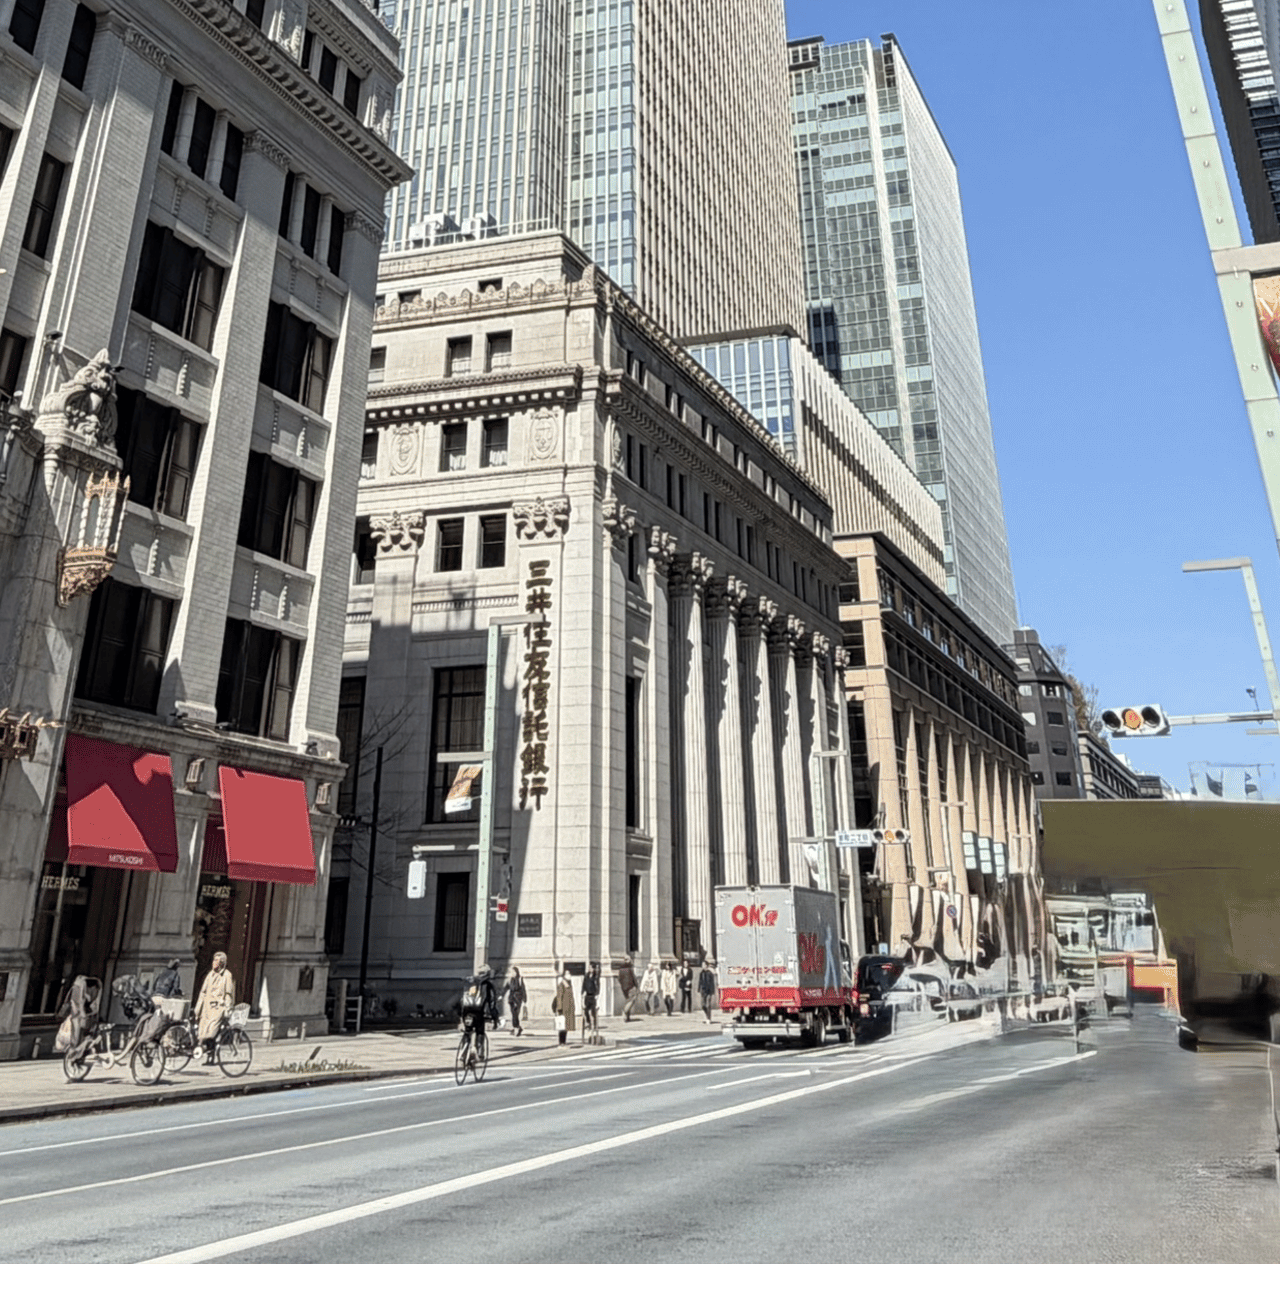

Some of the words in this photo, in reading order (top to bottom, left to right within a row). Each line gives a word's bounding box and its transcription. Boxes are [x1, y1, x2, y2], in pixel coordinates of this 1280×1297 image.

[519, 559, 553, 812] 三井住友信託銀行
